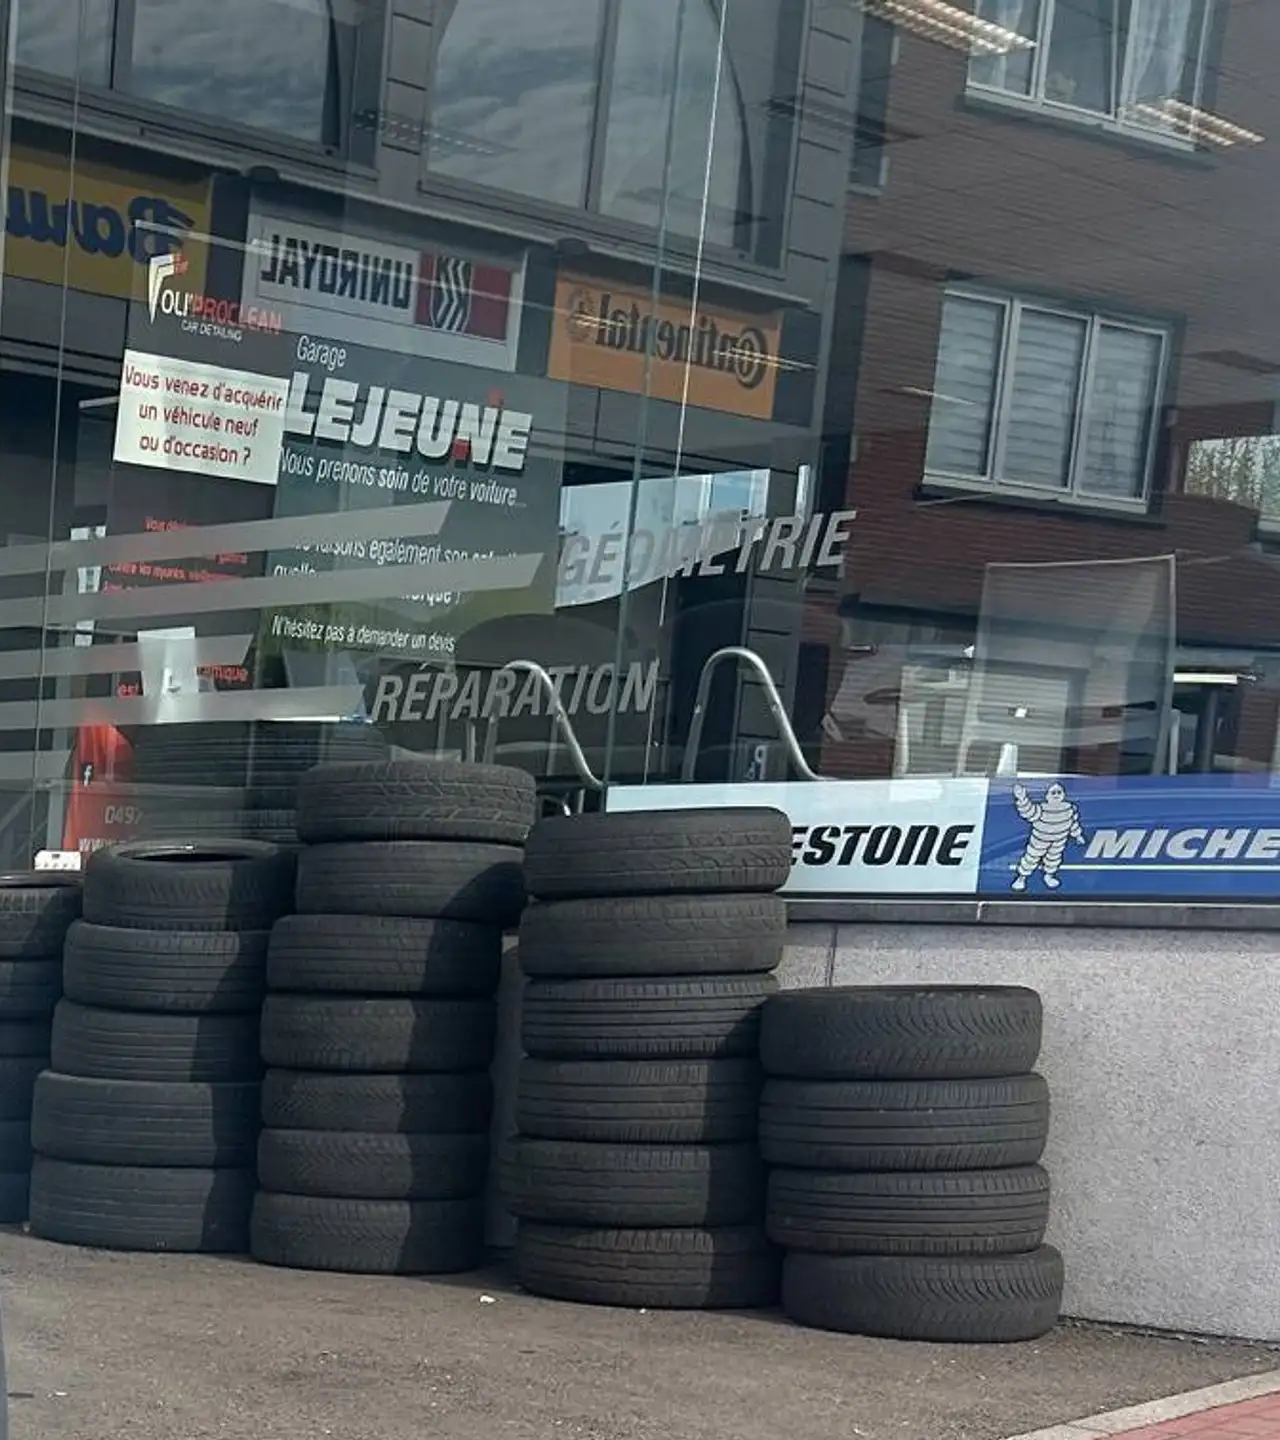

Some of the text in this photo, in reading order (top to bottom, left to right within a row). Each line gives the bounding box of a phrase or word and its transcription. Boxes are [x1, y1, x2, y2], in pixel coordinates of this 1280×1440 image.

[297, 335, 347, 372] Garage
[125, 364, 283, 411] Vous venez d'acquérir
[139, 403, 259, 438] un véhicule neuf
[284, 372, 532, 470] LEJEUNE
[139, 435, 251, 466] ou d'occasion ?
[280, 446, 314, 476] Nous
[315, 459, 376, 487] prenons
[378, 466, 409, 491] soin
[411, 469, 430, 494] de
[434, 475, 467, 500] votre
[324, 625, 345, 644] pas
[346, 625, 355, 643] à
[357, 625, 409, 648] demander
[411, 632, 426, 649] un
[428, 631, 455, 652] devis
[372, 659, 658, 721] RÉPARATION
[1084, 827, 1280, 860] MICHE
